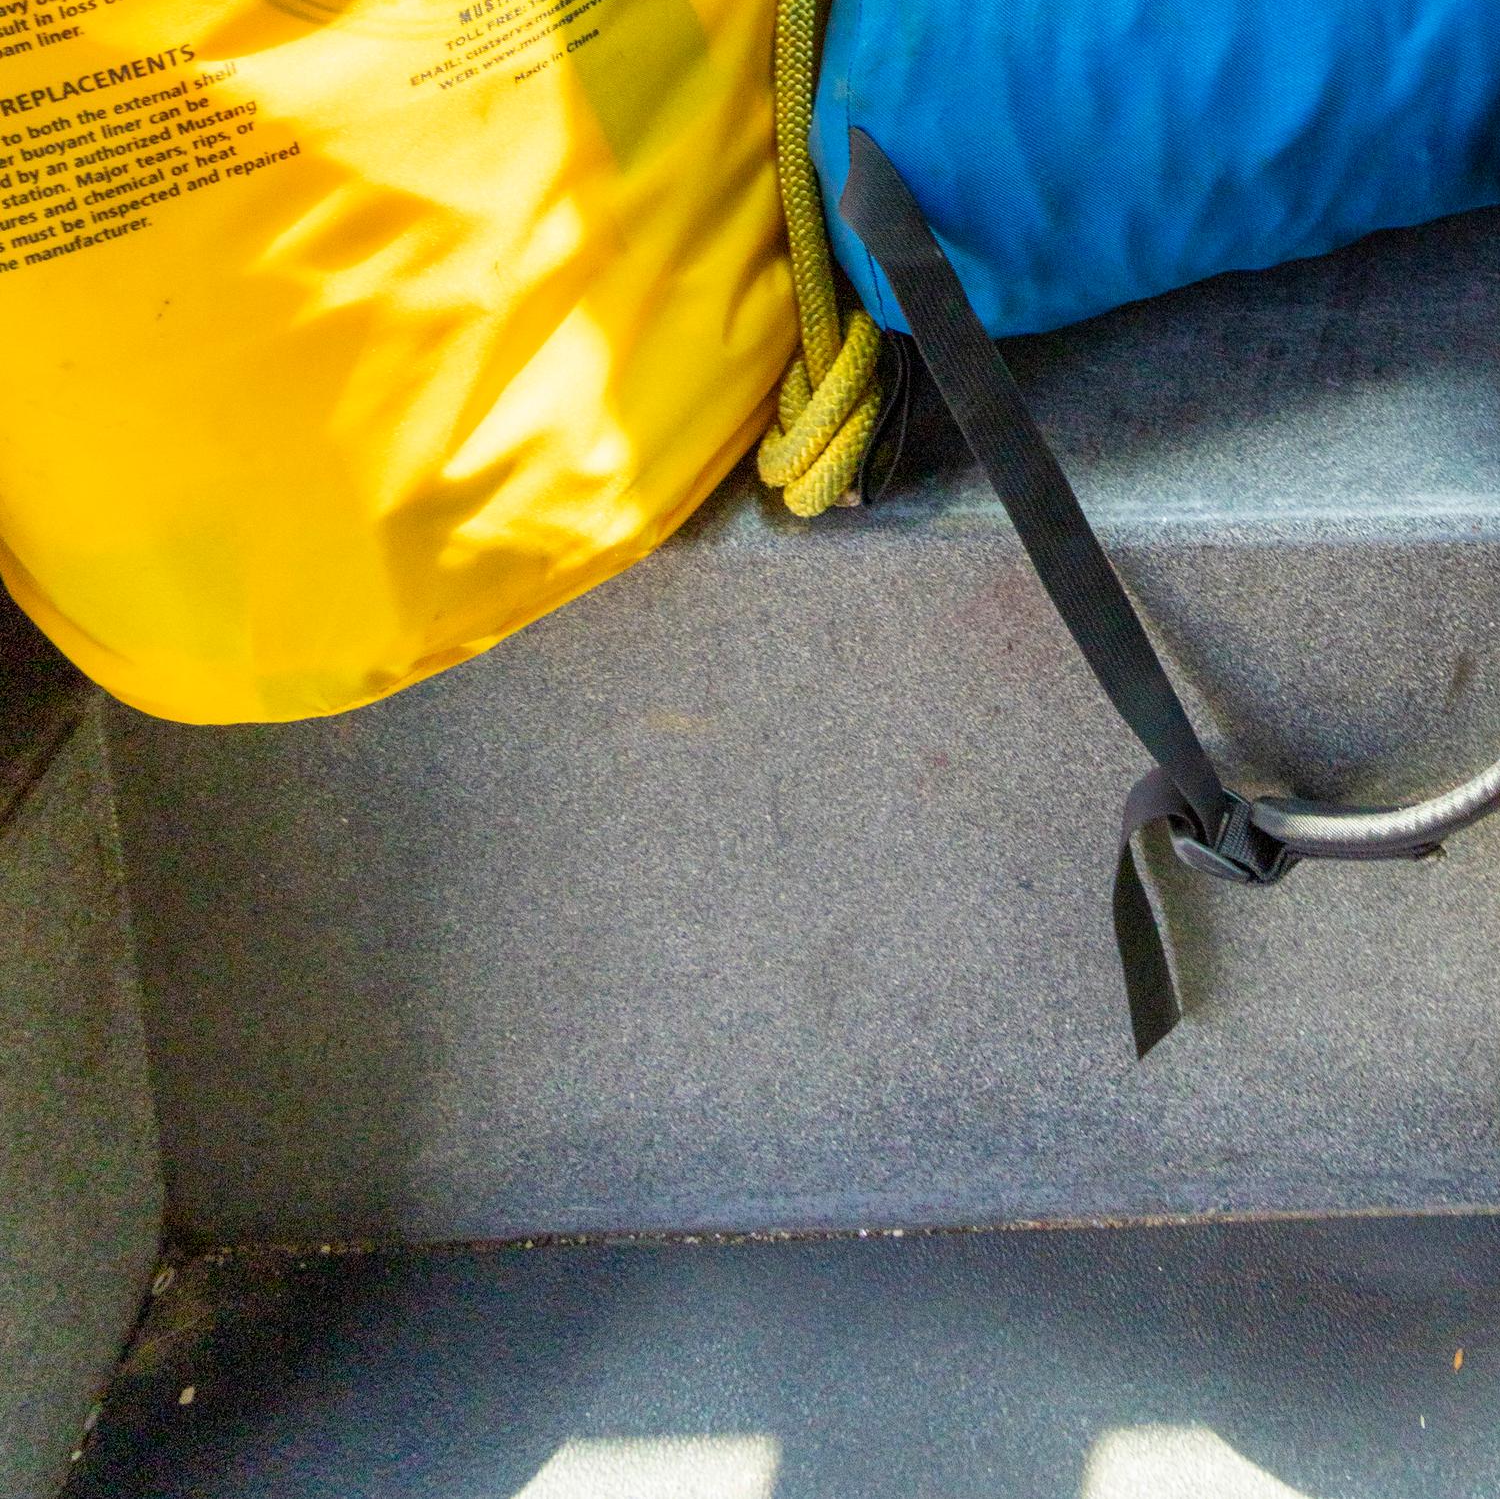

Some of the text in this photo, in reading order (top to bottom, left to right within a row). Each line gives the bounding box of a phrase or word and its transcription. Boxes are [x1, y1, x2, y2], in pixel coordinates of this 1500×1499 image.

[34, 11, 53, 27] in
[36, 25, 85, 46] liner.
[515, 28, 599, 82] Made in China
[1, 44, 195, 117] REPLACEMENTS
[2, 61, 238, 147] to both the external shell
[3, 120, 255, 210] station. Major tears, rips, or
[17, 100, 258, 186] by an authorized Mustang
[21, 96, 209, 162] buoyant liner can be
[11, 142, 300, 249] must be inspected and repaired
[44, 145, 237, 219] and chemical or heat
[24, 215, 152, 265] manufacturer.
